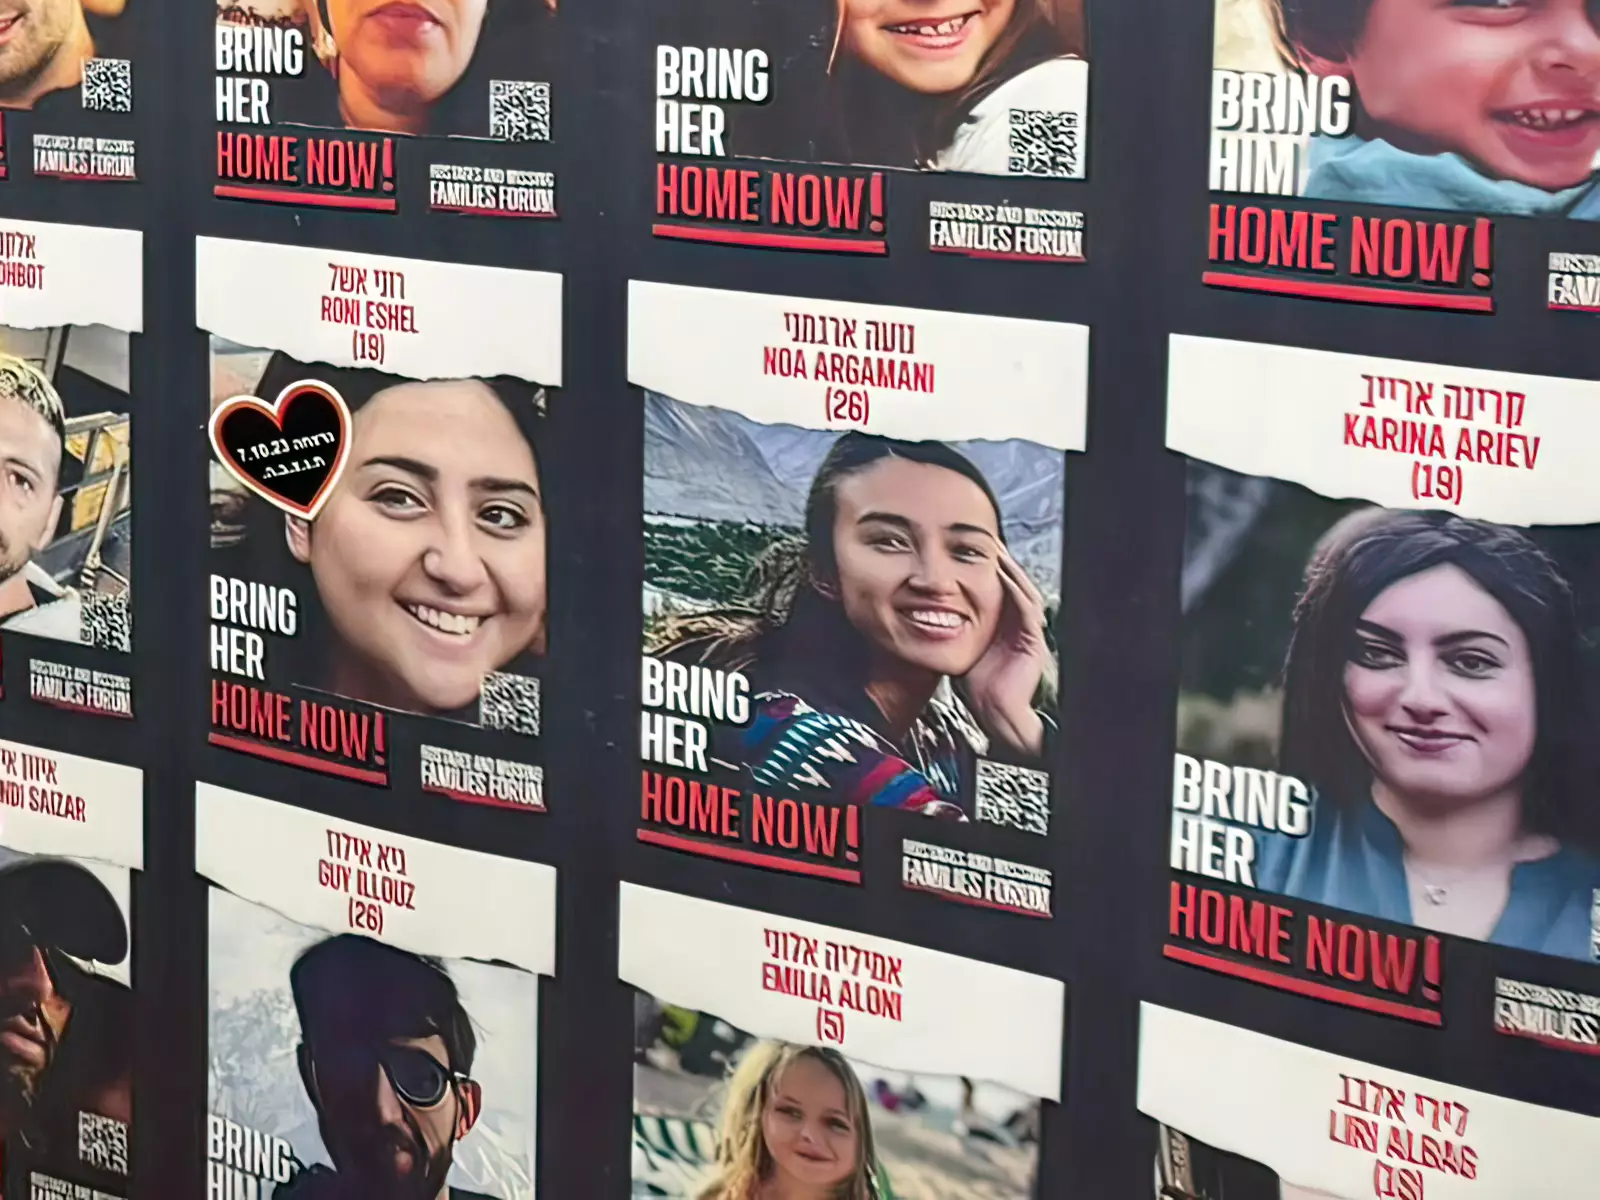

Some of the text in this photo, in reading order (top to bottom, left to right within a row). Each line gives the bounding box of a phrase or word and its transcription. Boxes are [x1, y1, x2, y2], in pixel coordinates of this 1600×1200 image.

[657, 46, 769, 101] BRING
[657, 99, 725, 155] HER
[656, 164, 883, 231] HOME NOW!
[321, 295, 418, 334] RONI ESHEL
[352, 329, 385, 365] (19)
[763, 346, 935, 393] NOA ARGAMANI
[825, 386, 870, 425] (26)
[1343, 414, 1541, 469] KARINA ARIEV
[1411, 461, 1463, 505] (19)
[642, 658, 749, 723] BRING
[642, 714, 708, 771] HER
[28, 785, 86, 822] SAIZAR
[642, 774, 859, 862] HOME NOW!
[318, 858, 416, 910] GUY ILLOUZ
[348, 897, 384, 936] (26)
[762, 962, 902, 1021] EMILIA ALONI
[816, 1006, 845, 1045] (5)
[208, 1115, 293, 1182] BRING
